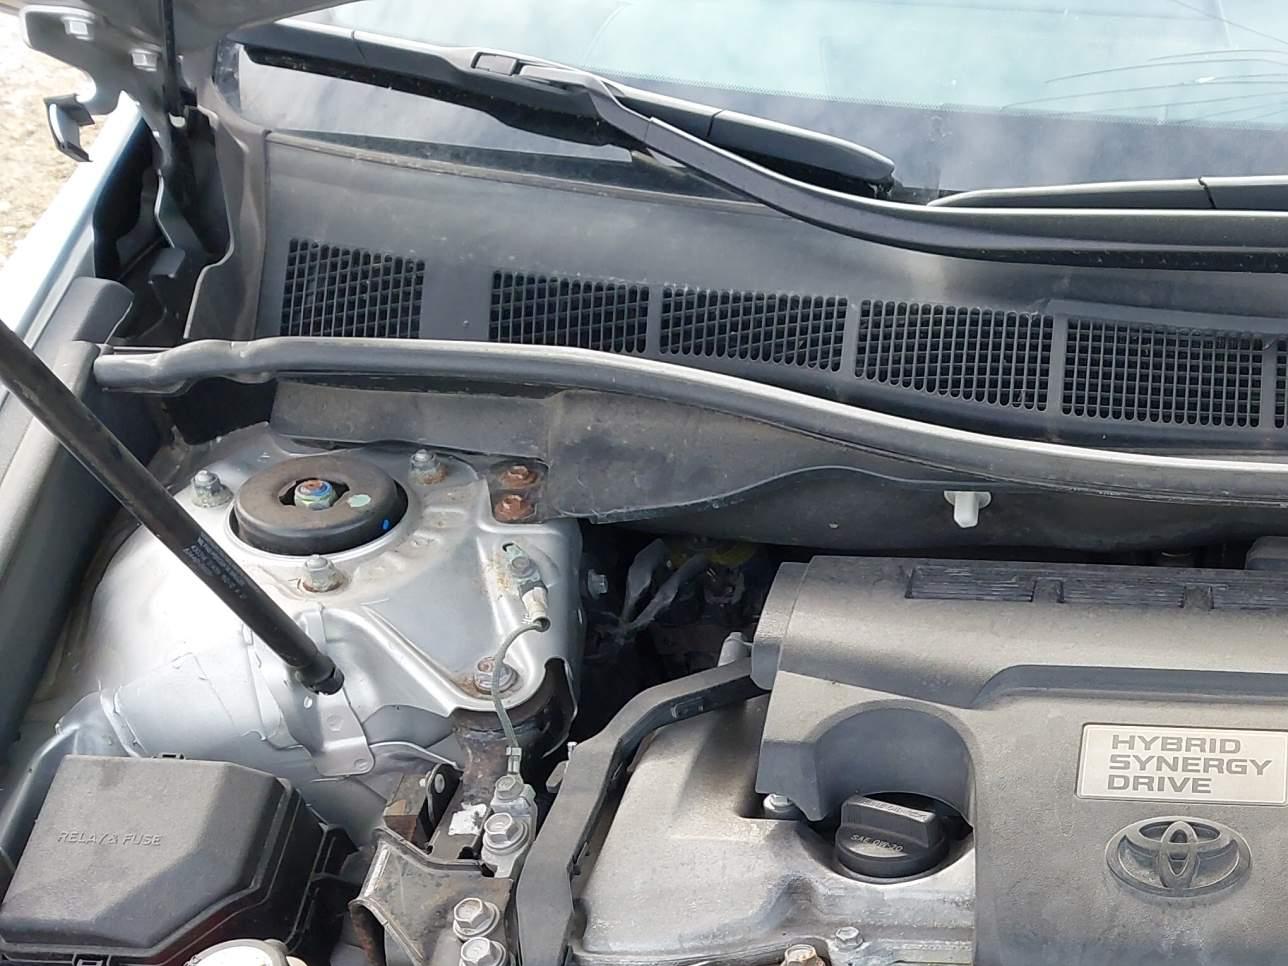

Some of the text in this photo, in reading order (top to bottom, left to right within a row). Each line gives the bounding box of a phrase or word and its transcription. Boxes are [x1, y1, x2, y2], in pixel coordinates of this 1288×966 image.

[1111, 734, 1241, 754] HYBRID
[1108, 754, 1272, 776] SYNERGY
[1107, 774, 1212, 794] DRIVE
[57, 831, 108, 845] RELAY
[122, 833, 163, 847] FUSE
[850, 834, 871, 843] SAE
